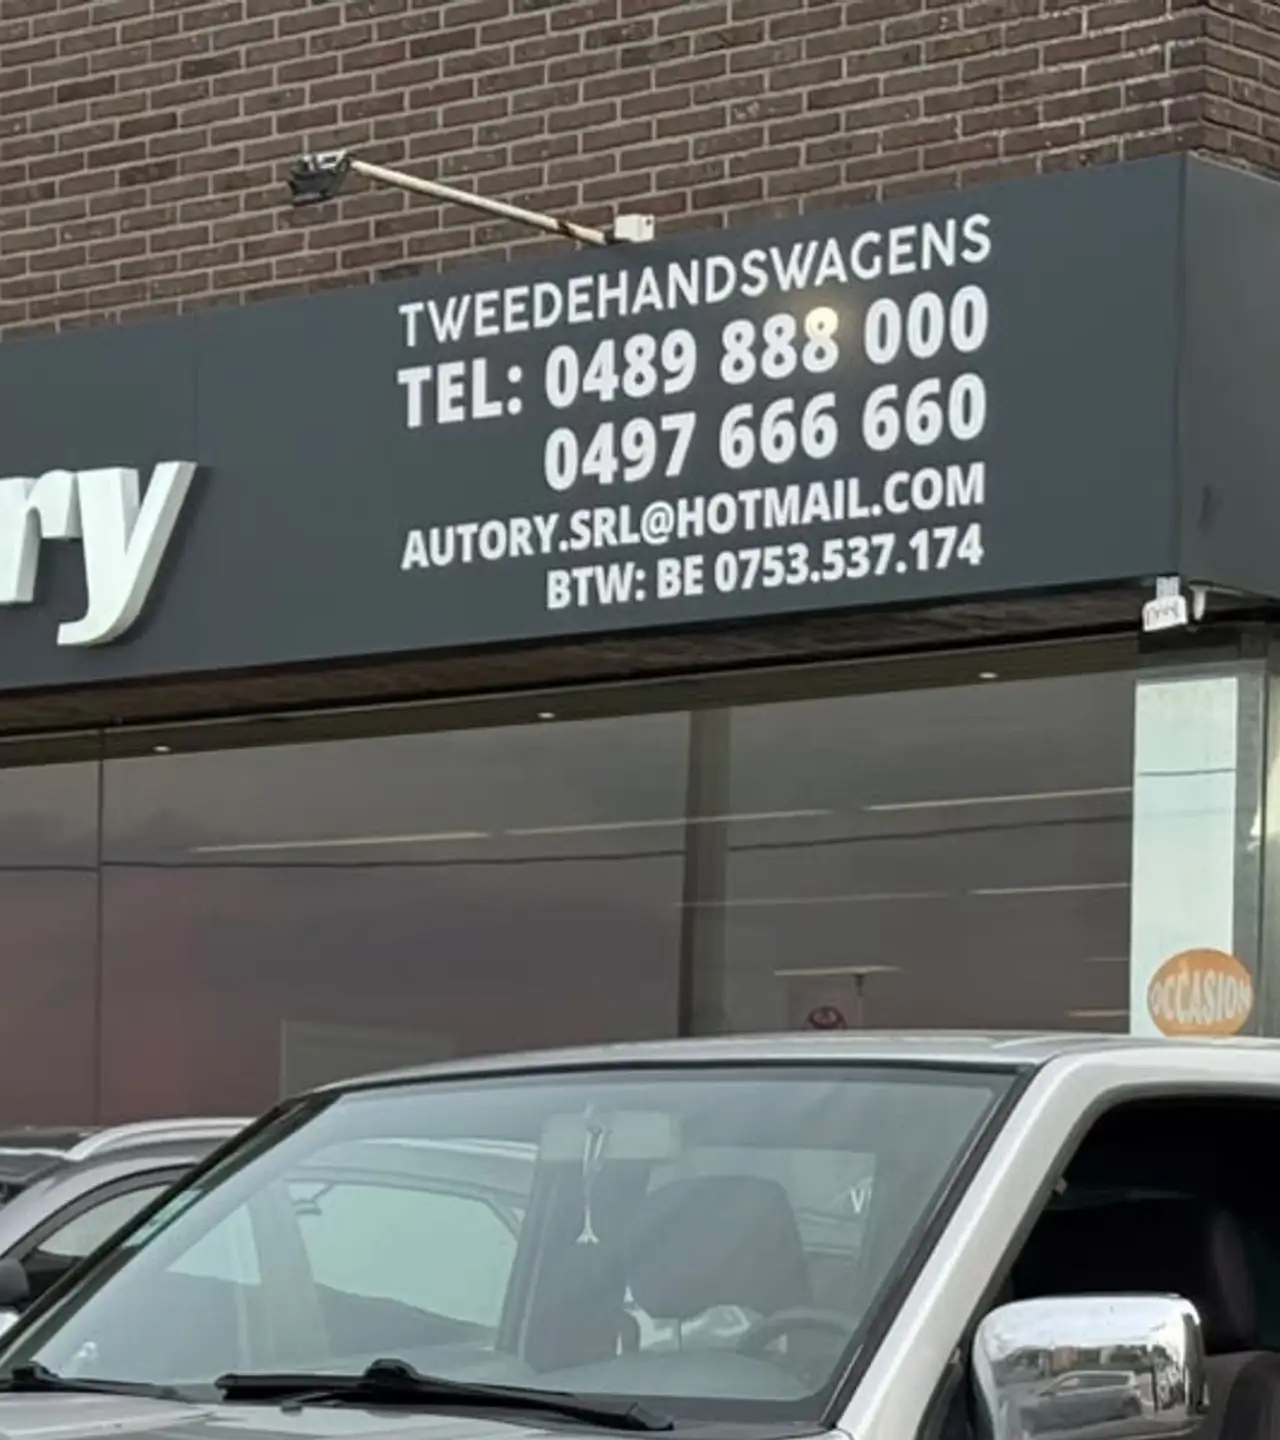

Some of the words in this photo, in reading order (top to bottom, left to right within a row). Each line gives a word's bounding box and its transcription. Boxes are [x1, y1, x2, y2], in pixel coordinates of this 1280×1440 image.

[398, 213, 991, 347] TWEEDEHANDSWAGENS
[397, 357, 523, 428] TEL:
[545, 329, 697, 408] 0489
[720, 306, 840, 385] 888
[864, 285, 988, 365] 000
[544, 411, 696, 491] 0497
[719, 392, 838, 469] 666
[862, 373, 986, 451] 660
[401, 462, 985, 570] AUTORY.SRL@HOTMAIL.COM
[547, 561, 646, 609] BTW:
[657, 554, 704, 599] BE
[714, 523, 984, 592] 0753.537.174
[1150, 968, 1253, 1025] OCCASION
